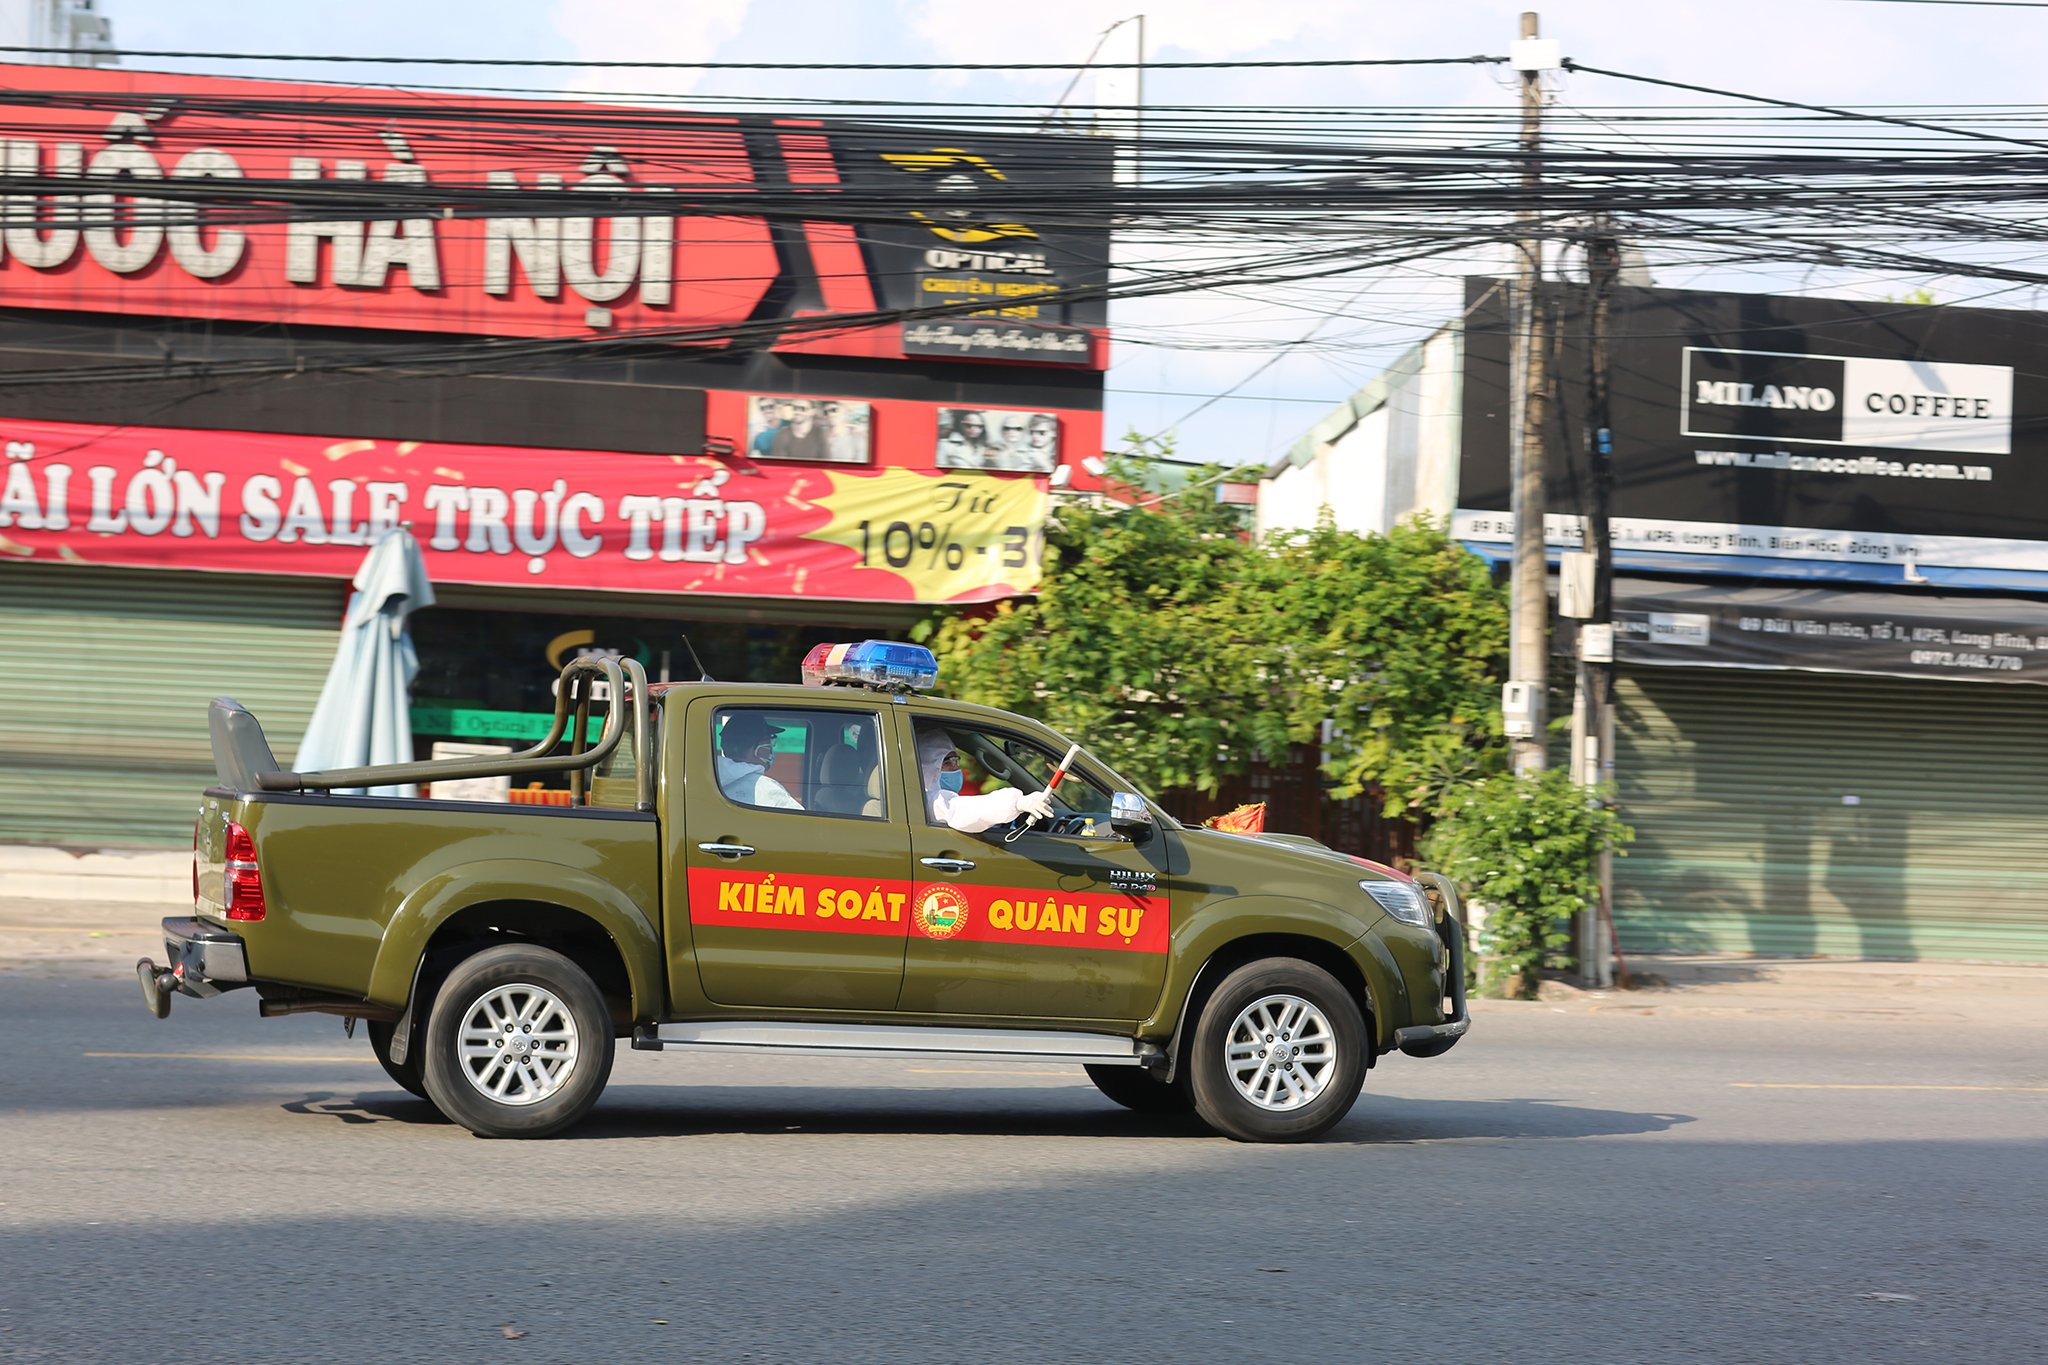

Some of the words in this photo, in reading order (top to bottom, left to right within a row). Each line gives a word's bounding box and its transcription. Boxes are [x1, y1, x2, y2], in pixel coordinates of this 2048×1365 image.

[0, 99, 245, 277] UỐC
[285, 128, 440, 289] HÀ
[484, 146, 674, 327] NỘI
[1696, 381, 1836, 412] MILANO
[1866, 393, 1991, 419] COFFEE
[1695, 450, 1993, 481] www.milanocoffee.com.vn
[86, 448, 227, 539] LỚN
[239, 473, 409, 547] SALE
[424, 478, 606, 575] TRỰC
[618, 469, 767, 566] TIẾP
[1110, 869, 1157, 882] HILUX
[718, 873, 806, 917] KIỂM
[815, 885, 906, 923] SOÁT
[987, 897, 1088, 935] QUÂN
[1096, 906, 1144, 944] SỰ
